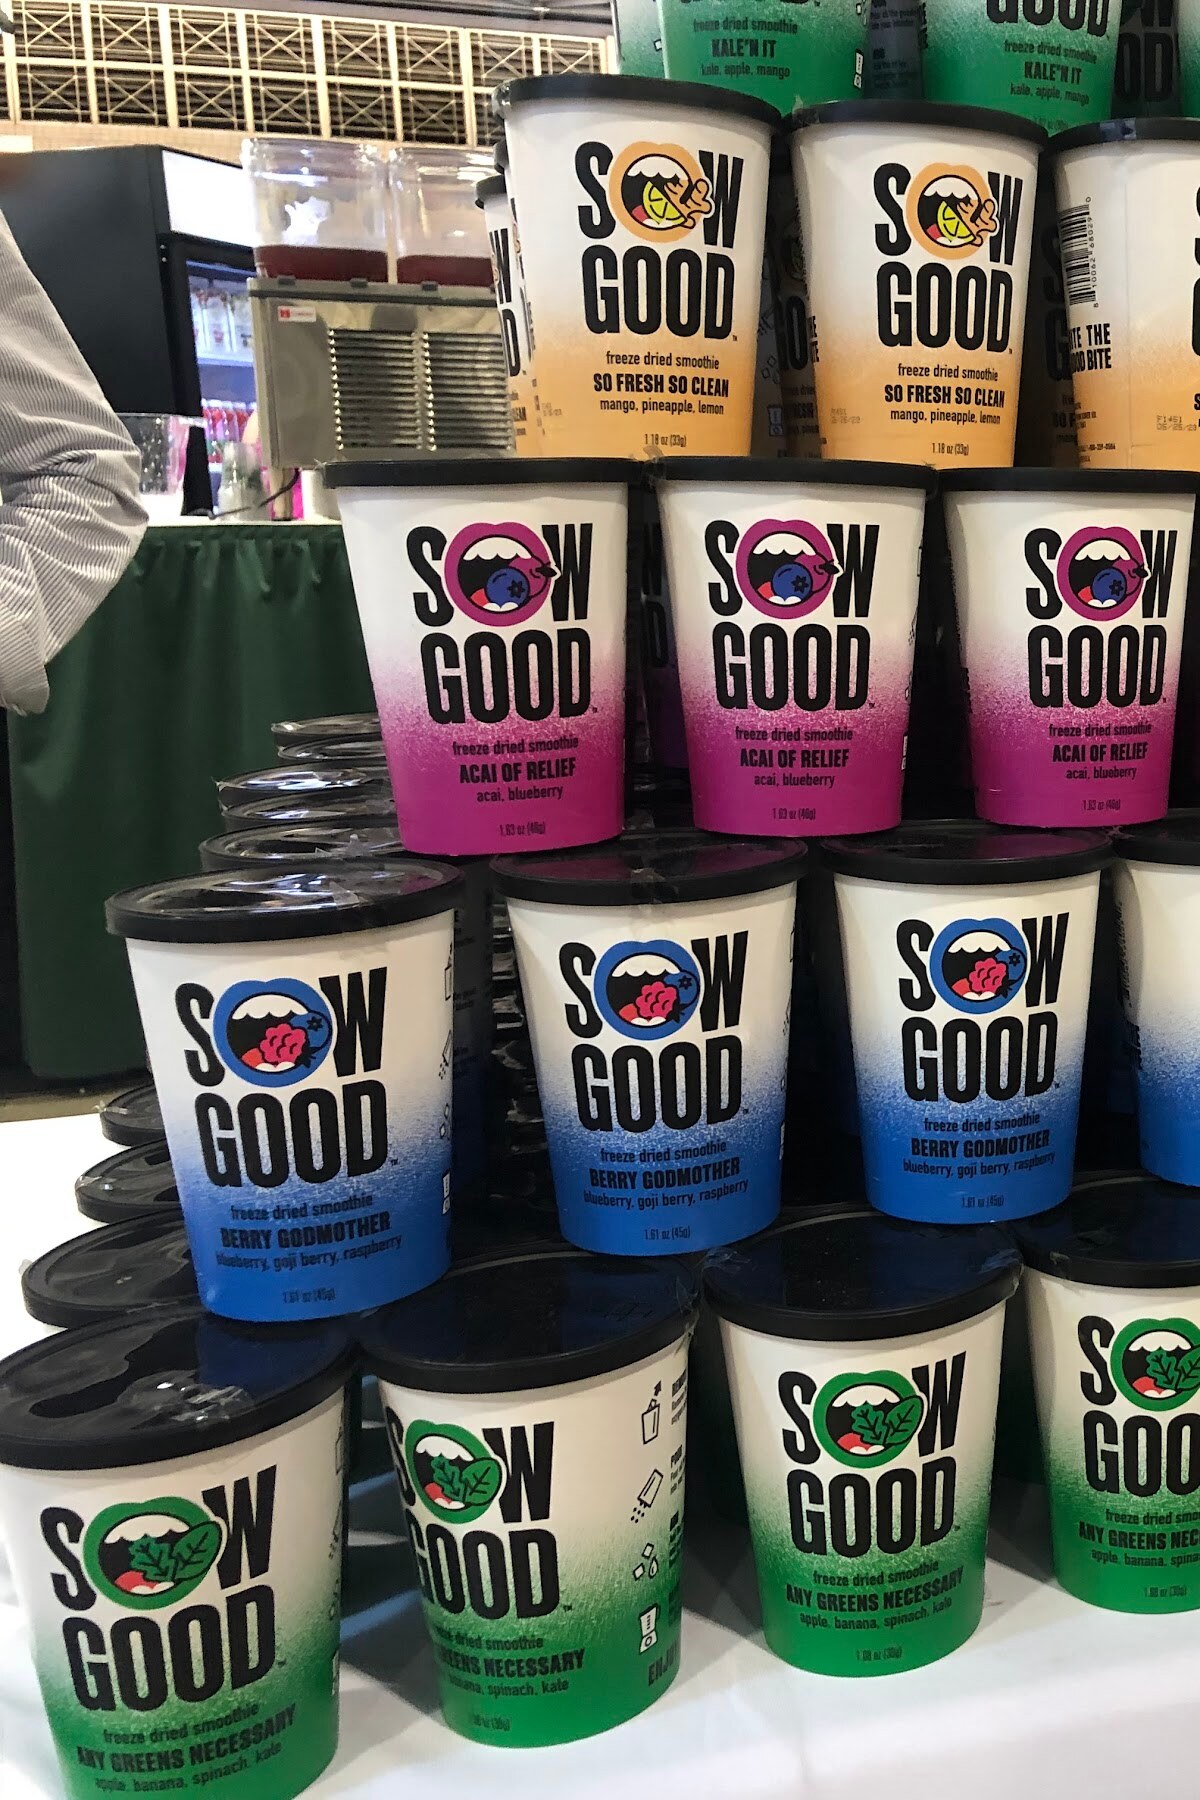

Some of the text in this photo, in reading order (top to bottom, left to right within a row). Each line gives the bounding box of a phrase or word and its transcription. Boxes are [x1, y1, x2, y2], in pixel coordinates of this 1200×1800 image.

[762, 39, 776, 58] IT
[757, 66, 790, 79] mango
[574, 141, 744, 248] SOW
[873, 162, 1023, 266] SOW
[581, 245, 736, 340] GOOD
[877, 262, 1013, 353] GOOD
[606, 351, 719, 369] freeze dried smoothie
[898, 363, 998, 381] freeze dried smoothie
[594, 373, 729, 397] SO FRESH SO CLEAN
[885, 384, 1005, 408] SO FRESH SO CLEAN
[600, 398, 724, 415] mango, pineapple, lemon
[891, 408, 1000, 425] mango, pineapple, lemon
[405, 521, 593, 627] SOW
[705, 518, 880, 620] SOW
[1024, 526, 1178, 622] SOW
[420, 628, 591, 724] GOOD
[711, 622, 872, 712] GOOD
[1027, 624, 1167, 709] GOOD
[735, 726, 854, 743] freeze dried smoothie
[1049, 722, 1152, 738] freeze dried smoothie
[453, 735, 579, 755] freeze dried smoothie
[739, 749, 849, 769] ACAI OF RELIEF
[1052, 742, 1148, 763] ACAI OF RELIEF
[460, 757, 576, 783] ACAI OF RELIEF
[754, 772, 835, 789] acai, blueberry
[1066, 765, 1137, 781] acai, blueberry
[477, 786, 563, 802] acai, blueberry
[897, 912, 1069, 1015] SOW
[558, 930, 749, 1041] SOW
[174, 966, 388, 1087] SOW
[901, 1011, 1058, 1104] GOOD
[570, 1033, 742, 1133] GOOD
[193, 1078, 389, 1188] GOOD
[924, 1111, 1040, 1132] freeze dried smoothie
[599, 1140, 727, 1165] freeze dried smoothie
[911, 1130, 1050, 1158] BERRY GODMOTHER
[589, 1157, 740, 1191] BERRY GODMOTHER
[957, 1162, 975, 1178] goji
[1013, 1150, 1056, 1173] raspberry
[271, 1199, 307, 1220] dried
[311, 1193, 373, 1218] smoothie
[638, 1192, 658, 1210] goji
[698, 1178, 749, 1202] raspberry
[220, 1211, 391, 1249] BERRY GODMOTHER
[778, 1351, 966, 1469] SOW
[786, 1456, 957, 1559] GOOD
[1105, 1508, 1140, 1525] freeze
[1143, 1508, 1172, 1524] dried
[39, 1464, 278, 1610] SOW
[1079, 1521, 1104, 1541] ANY
[1108, 1528, 1167, 1550] GREENS
[812, 1560, 939, 1586] freeze dried smoothie
[786, 1565, 964, 1613] ANY GREENS NECESSARY
[933, 1597, 953, 1613] kale
[61, 1584, 277, 1711] GOOD
